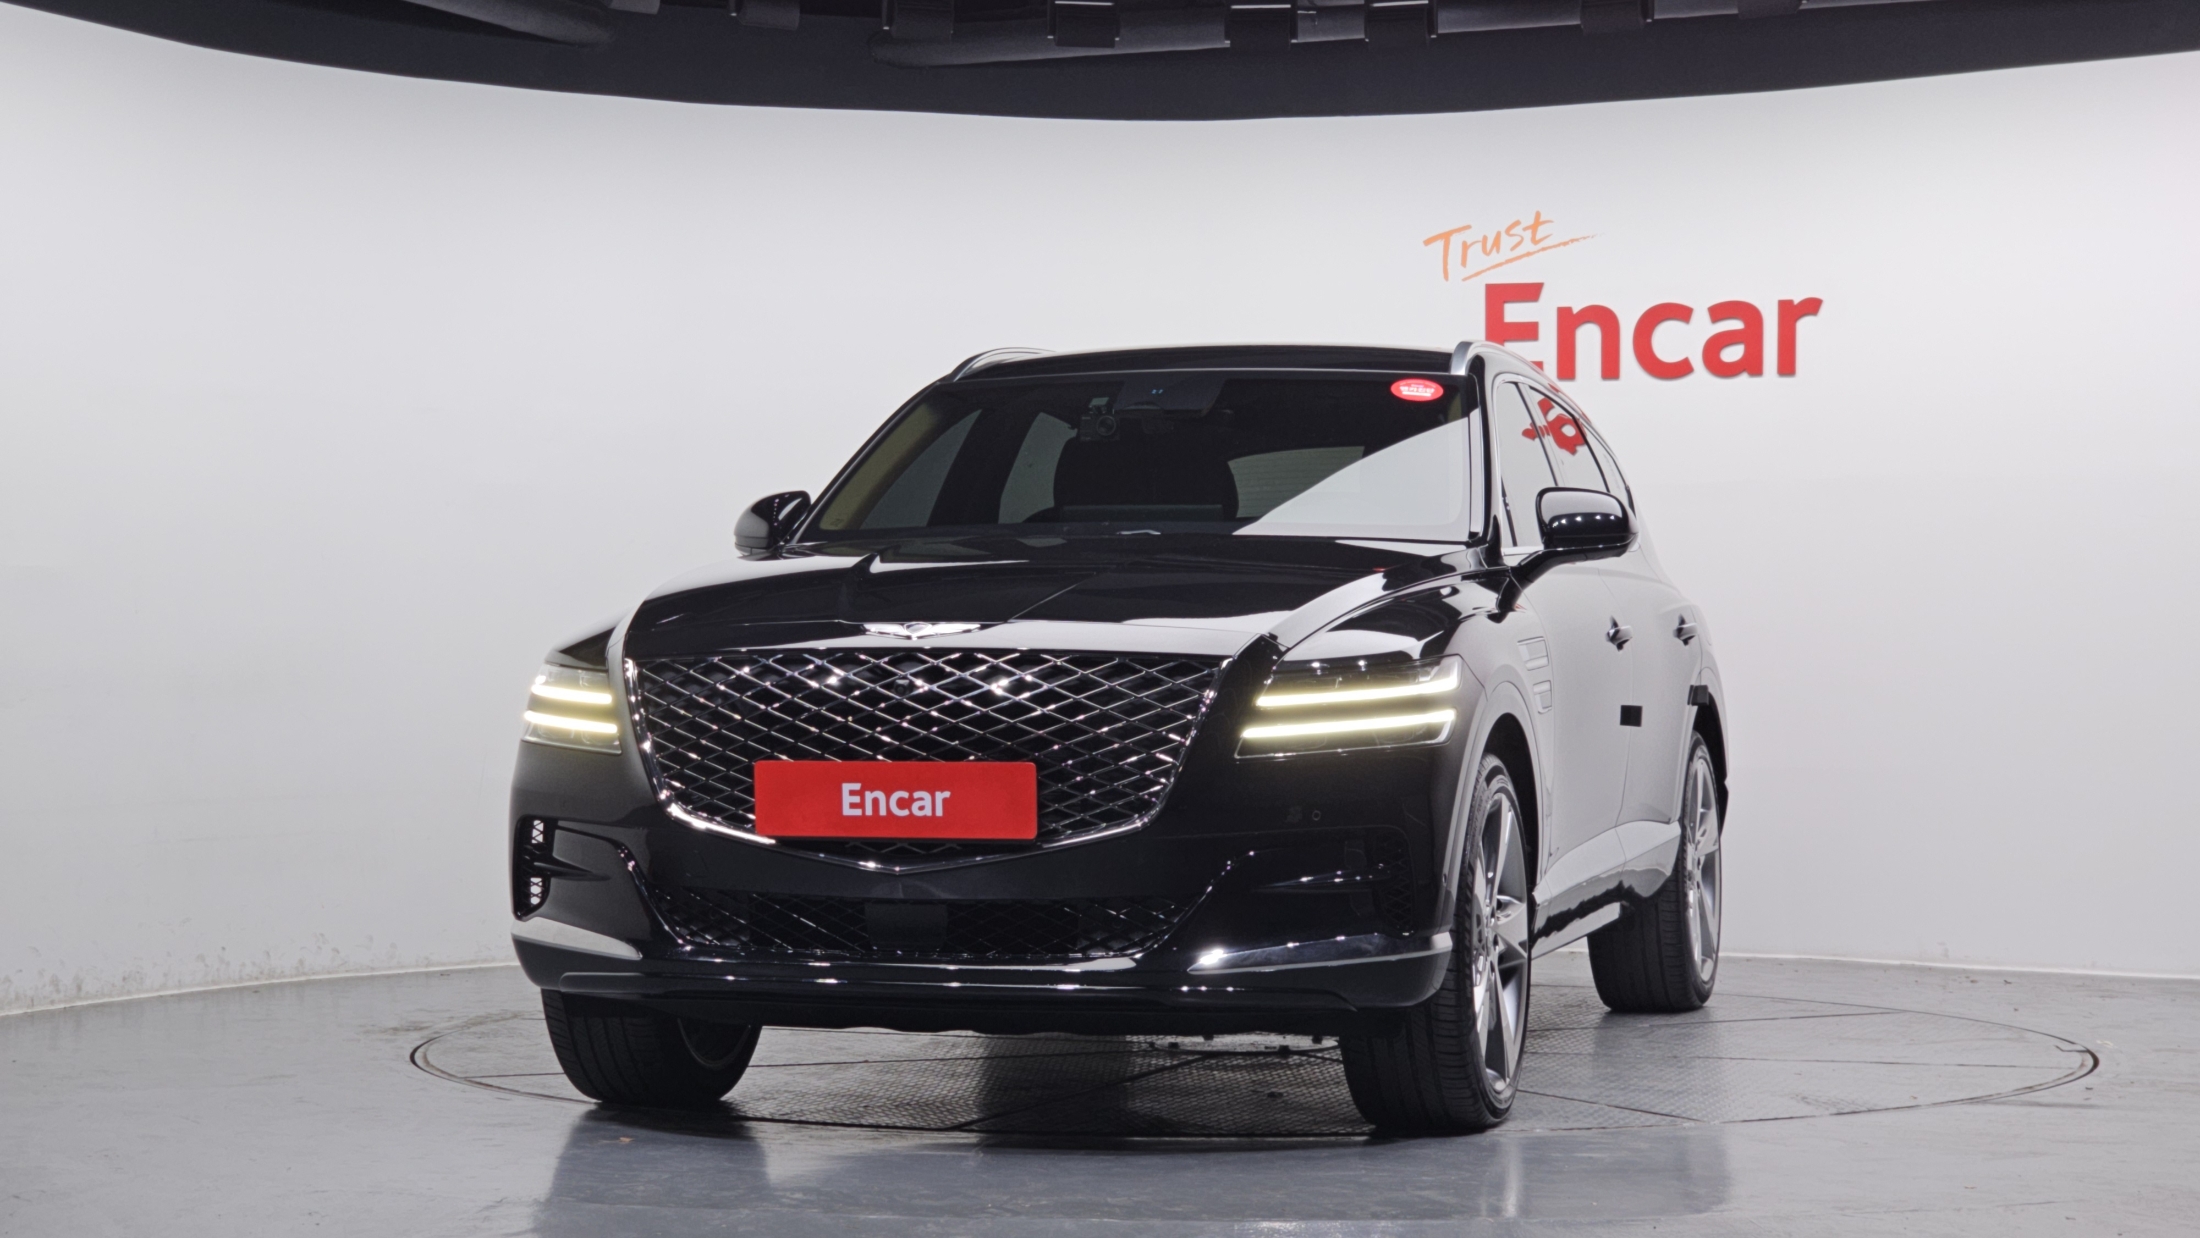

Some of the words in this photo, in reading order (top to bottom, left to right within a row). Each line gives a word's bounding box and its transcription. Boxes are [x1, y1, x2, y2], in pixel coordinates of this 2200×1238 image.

[1423, 210, 1554, 281] Trust
[1485, 282, 1823, 380] Encar
[841, 782, 951, 817] Encar
